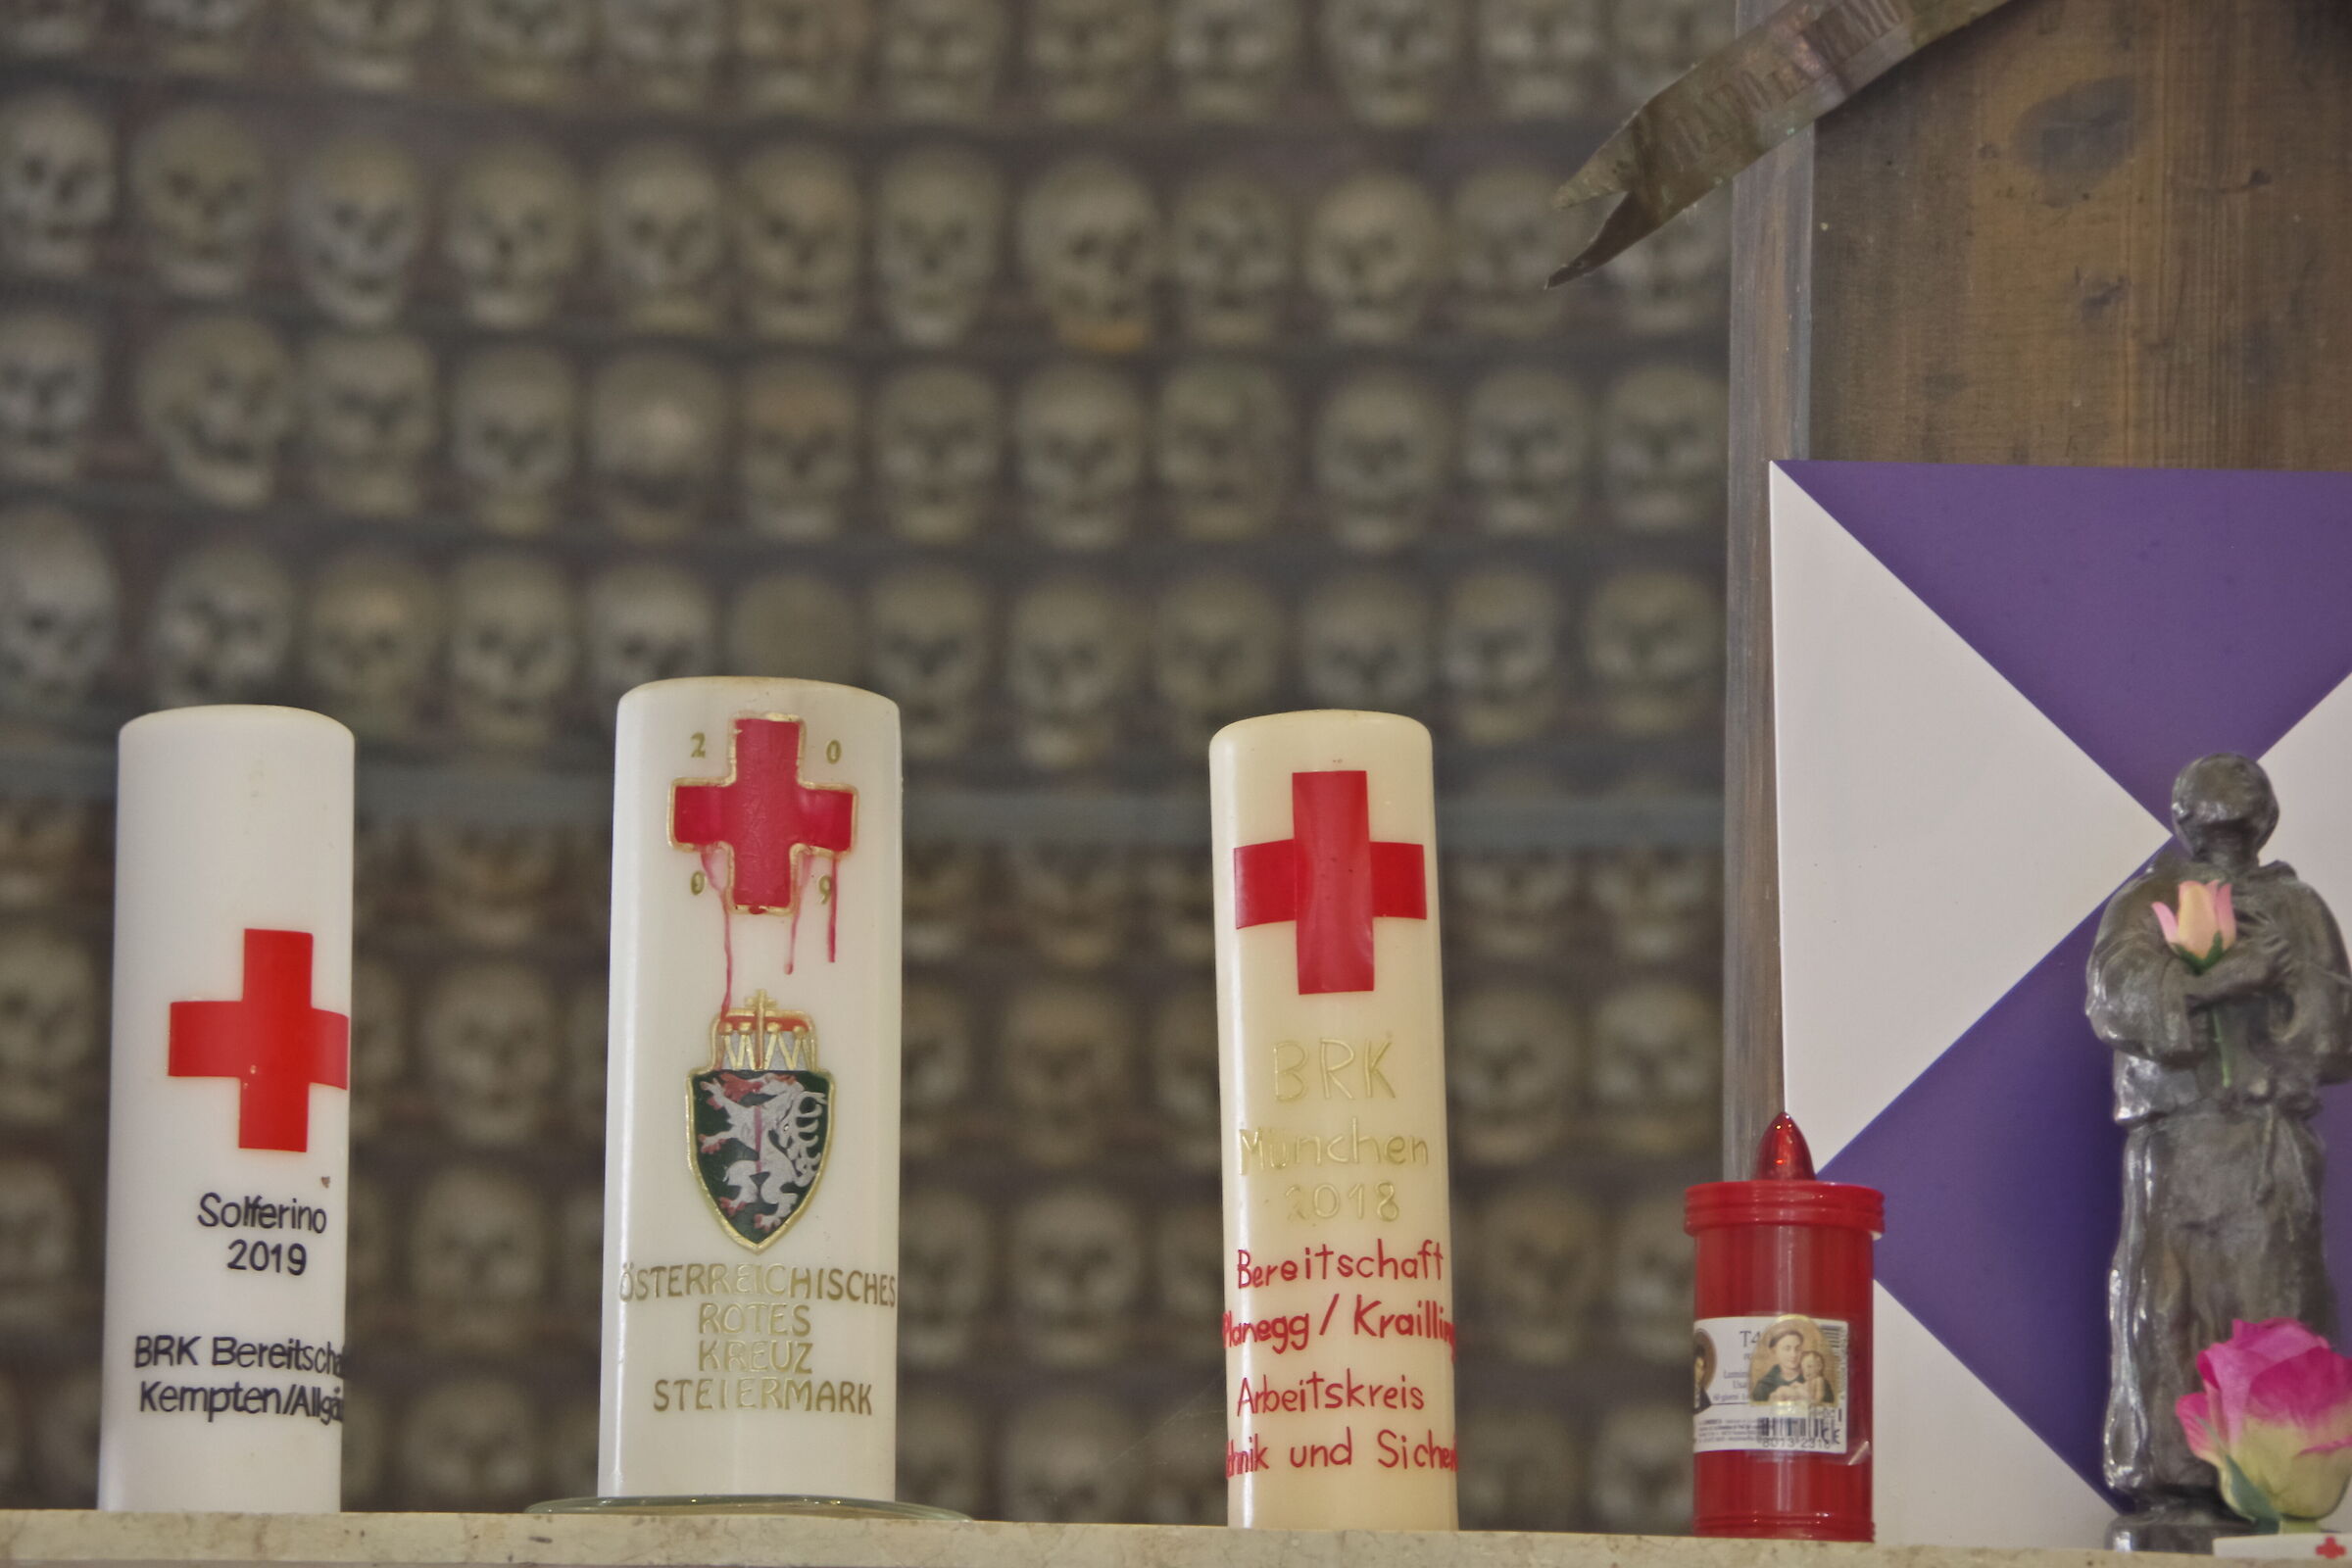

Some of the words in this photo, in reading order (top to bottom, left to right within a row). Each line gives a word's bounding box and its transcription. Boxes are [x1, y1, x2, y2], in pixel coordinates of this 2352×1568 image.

[690, 732, 707, 758] 2
[1273, 1037, 1396, 1103] BRK
[197, 1192, 327, 1234] Solferino
[1285, 1181, 1400, 1222] 2018
[226, 1239, 307, 1276] 2019
[1237, 1238, 1444, 1290] Bereitschaft
[618, 1262, 897, 1307] ÖSTERREICHISCHES
[699, 1302, 811, 1337] ROTES
[134, 1335, 202, 1369] BRK
[699, 1339, 813, 1374] KREUZ
[653, 1376, 873, 1416] STEIERMARK
[1237, 1367, 1425, 1417] Arbeitskreis
[1290, 1426, 1352, 1469] und
